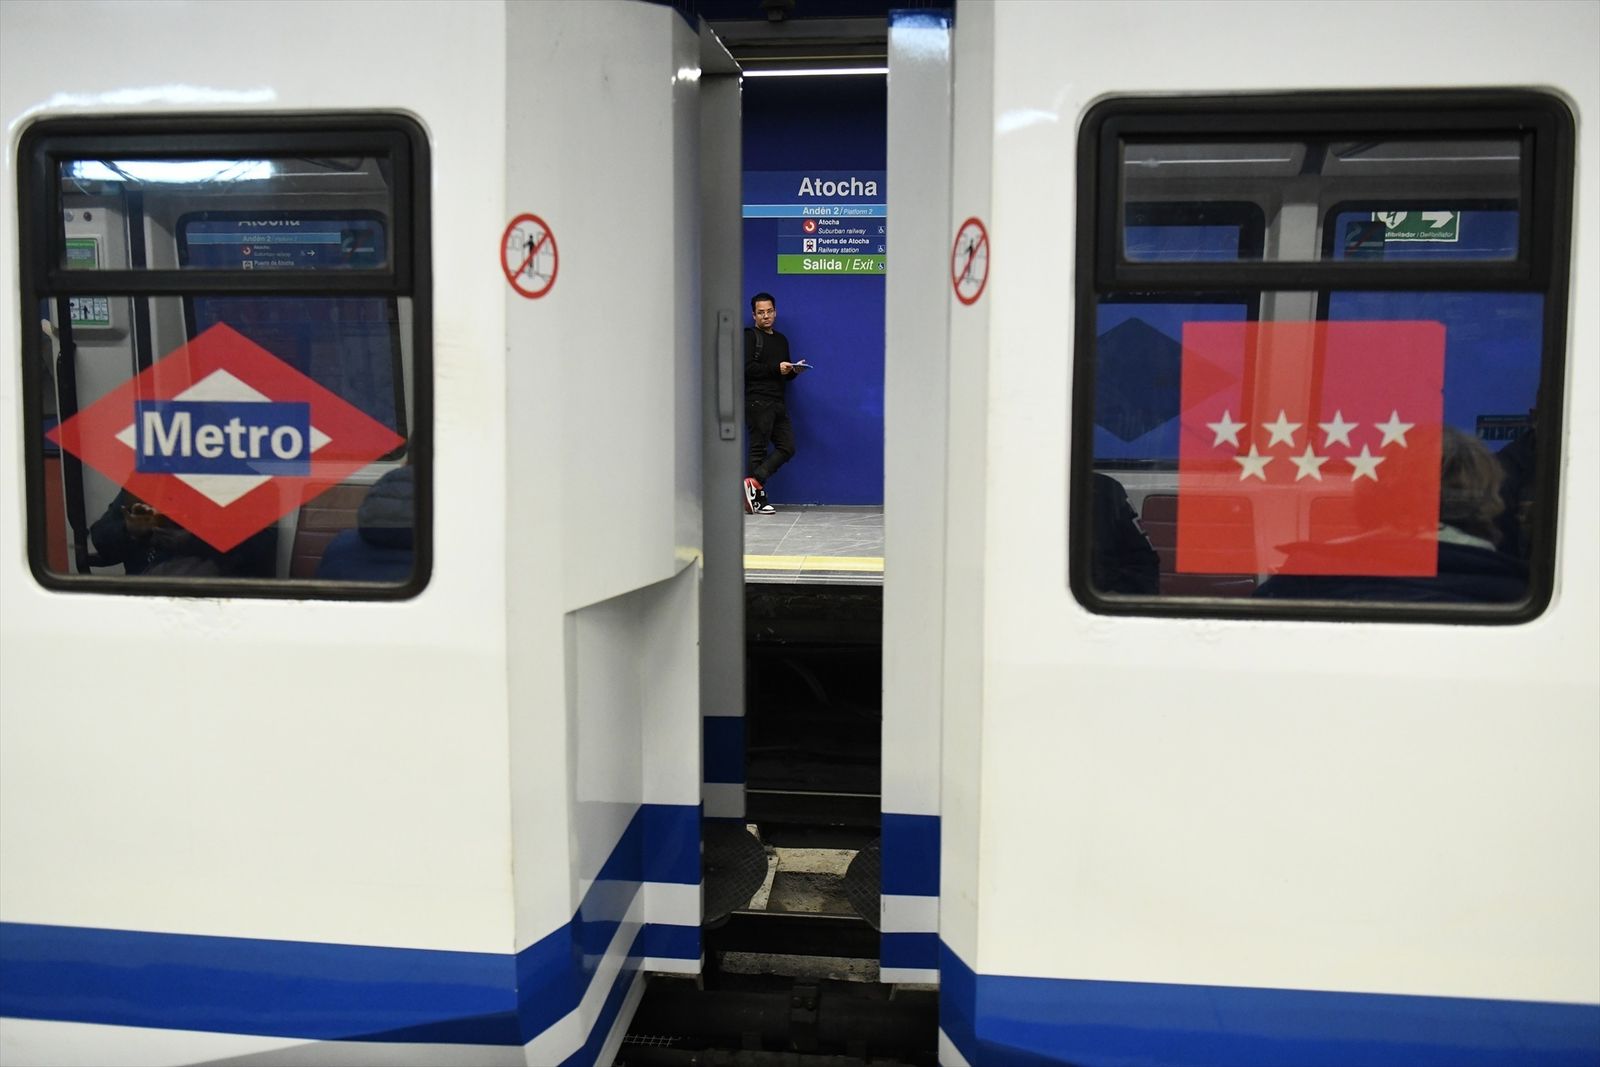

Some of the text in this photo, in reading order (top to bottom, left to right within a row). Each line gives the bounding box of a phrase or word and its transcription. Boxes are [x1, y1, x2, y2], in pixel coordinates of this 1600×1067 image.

[798, 176, 878, 196] Atocha
[802, 206, 831, 215] Andén
[818, 246, 840, 254] Railway
[803, 258, 874, 271] Salida / Exit
[143, 411, 303, 460] Metro
